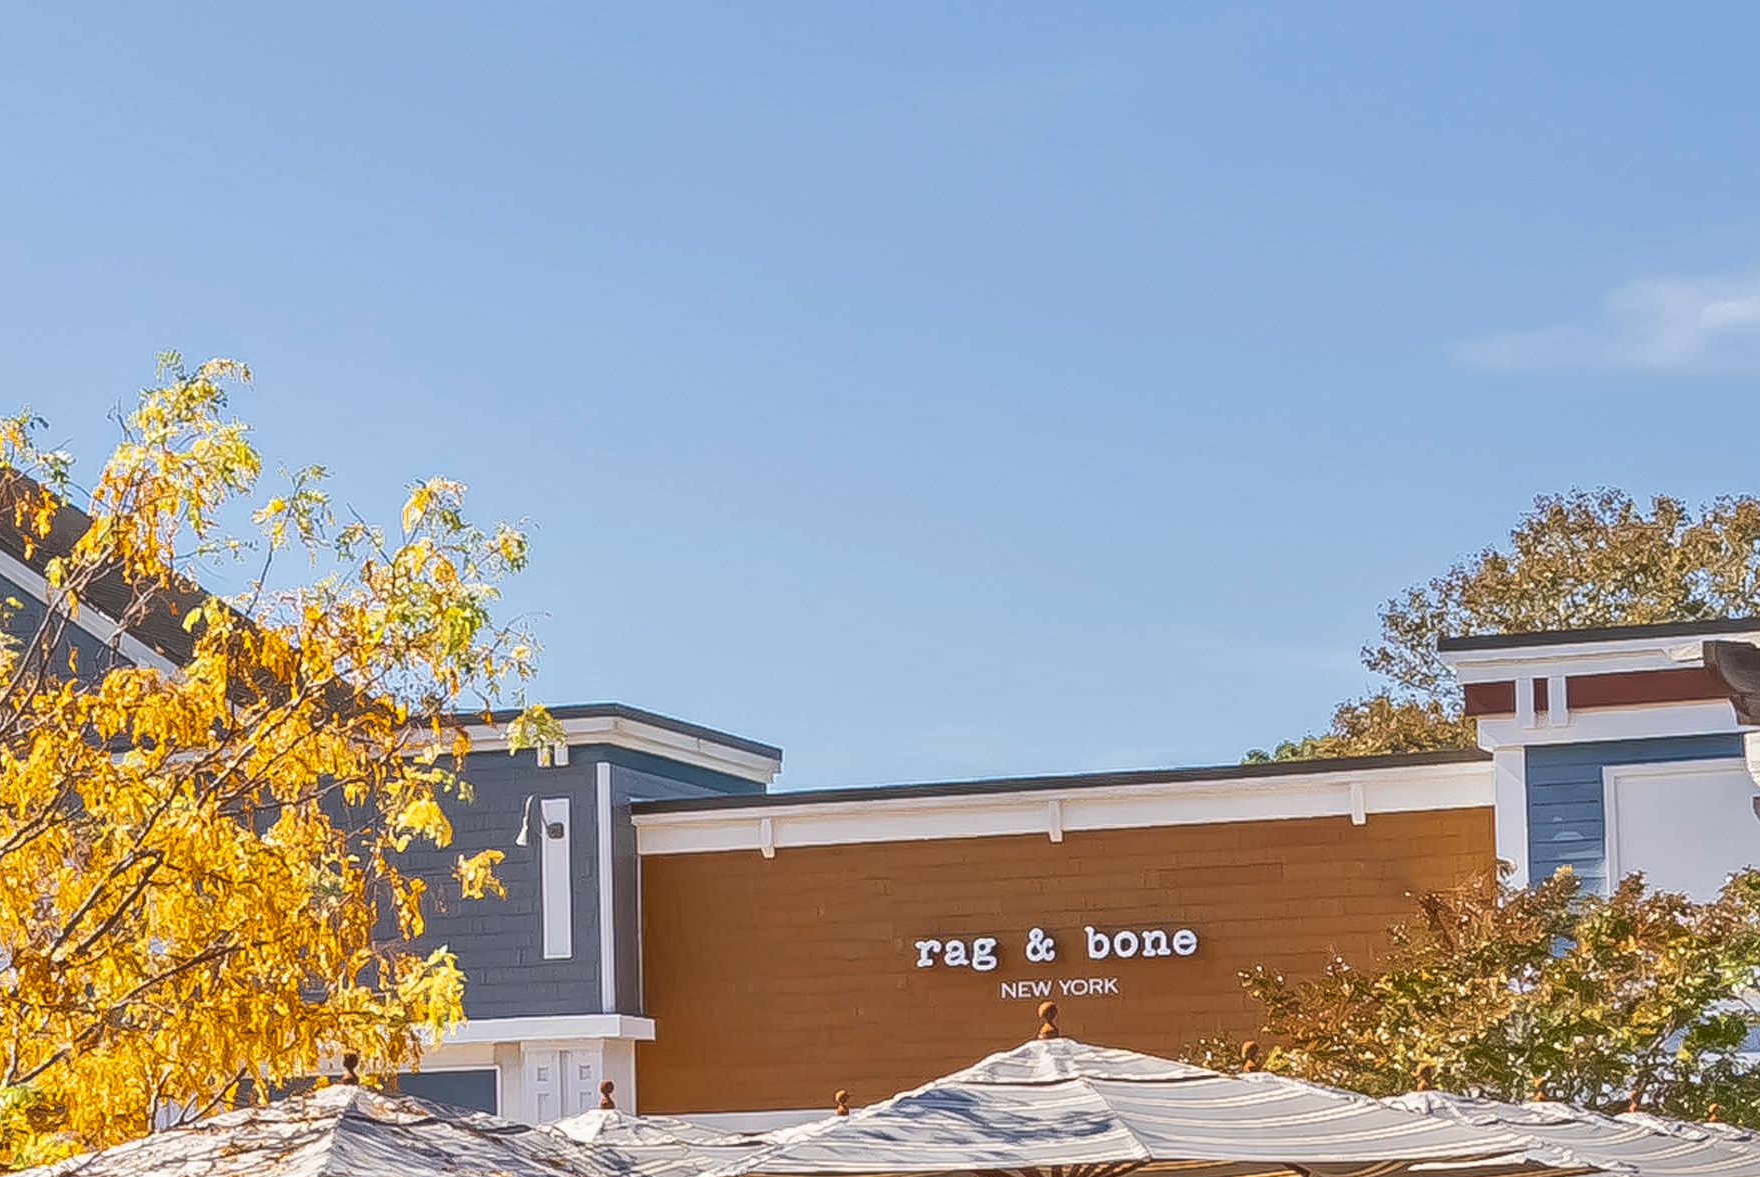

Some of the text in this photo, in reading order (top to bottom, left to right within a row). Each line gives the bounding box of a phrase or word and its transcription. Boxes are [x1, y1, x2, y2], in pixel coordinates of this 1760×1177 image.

[915, 925, 1198, 971] rag & bone
[1000, 977, 1120, 999] NEW YORK
